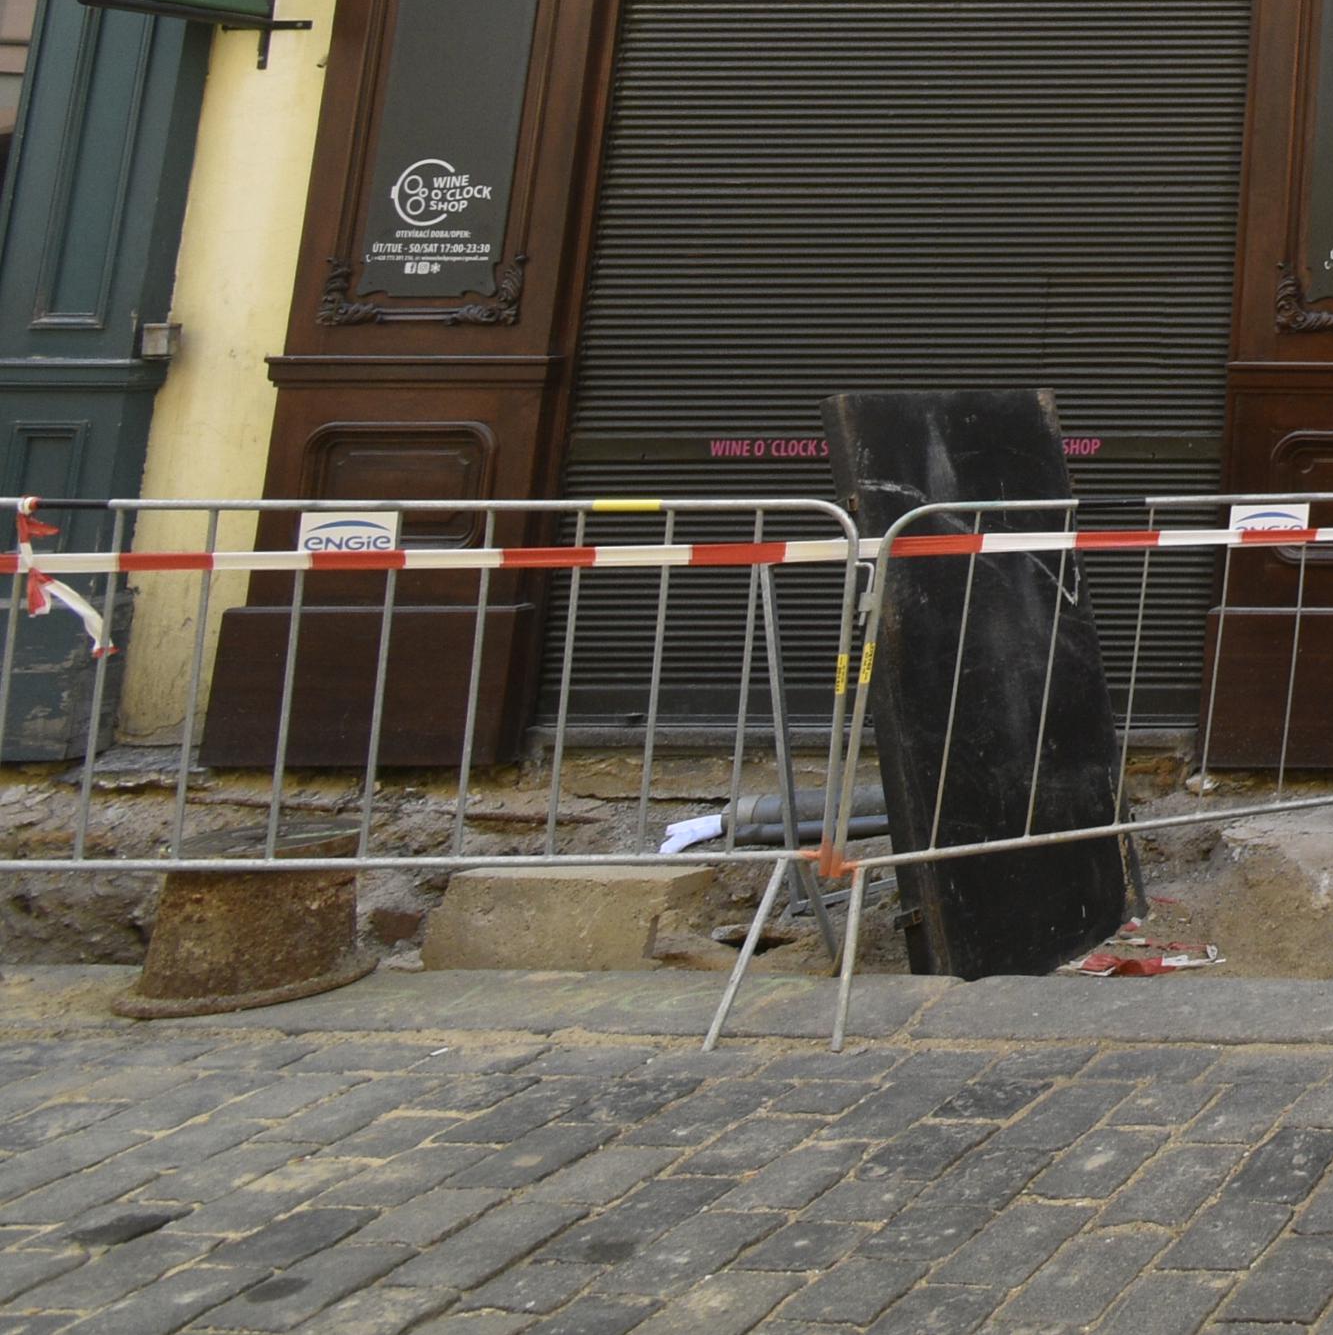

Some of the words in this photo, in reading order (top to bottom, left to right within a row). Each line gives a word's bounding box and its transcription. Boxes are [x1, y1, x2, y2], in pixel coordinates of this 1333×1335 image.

[433, 175, 470, 189] WINE
[429, 200, 468, 213] SHOP
[408, 243, 438, 254] SO/SAT
[440, 243, 491, 254] 17:00-23:30
[710, 439, 752, 457] WINE
[1062, 438, 1101, 456] SHOP
